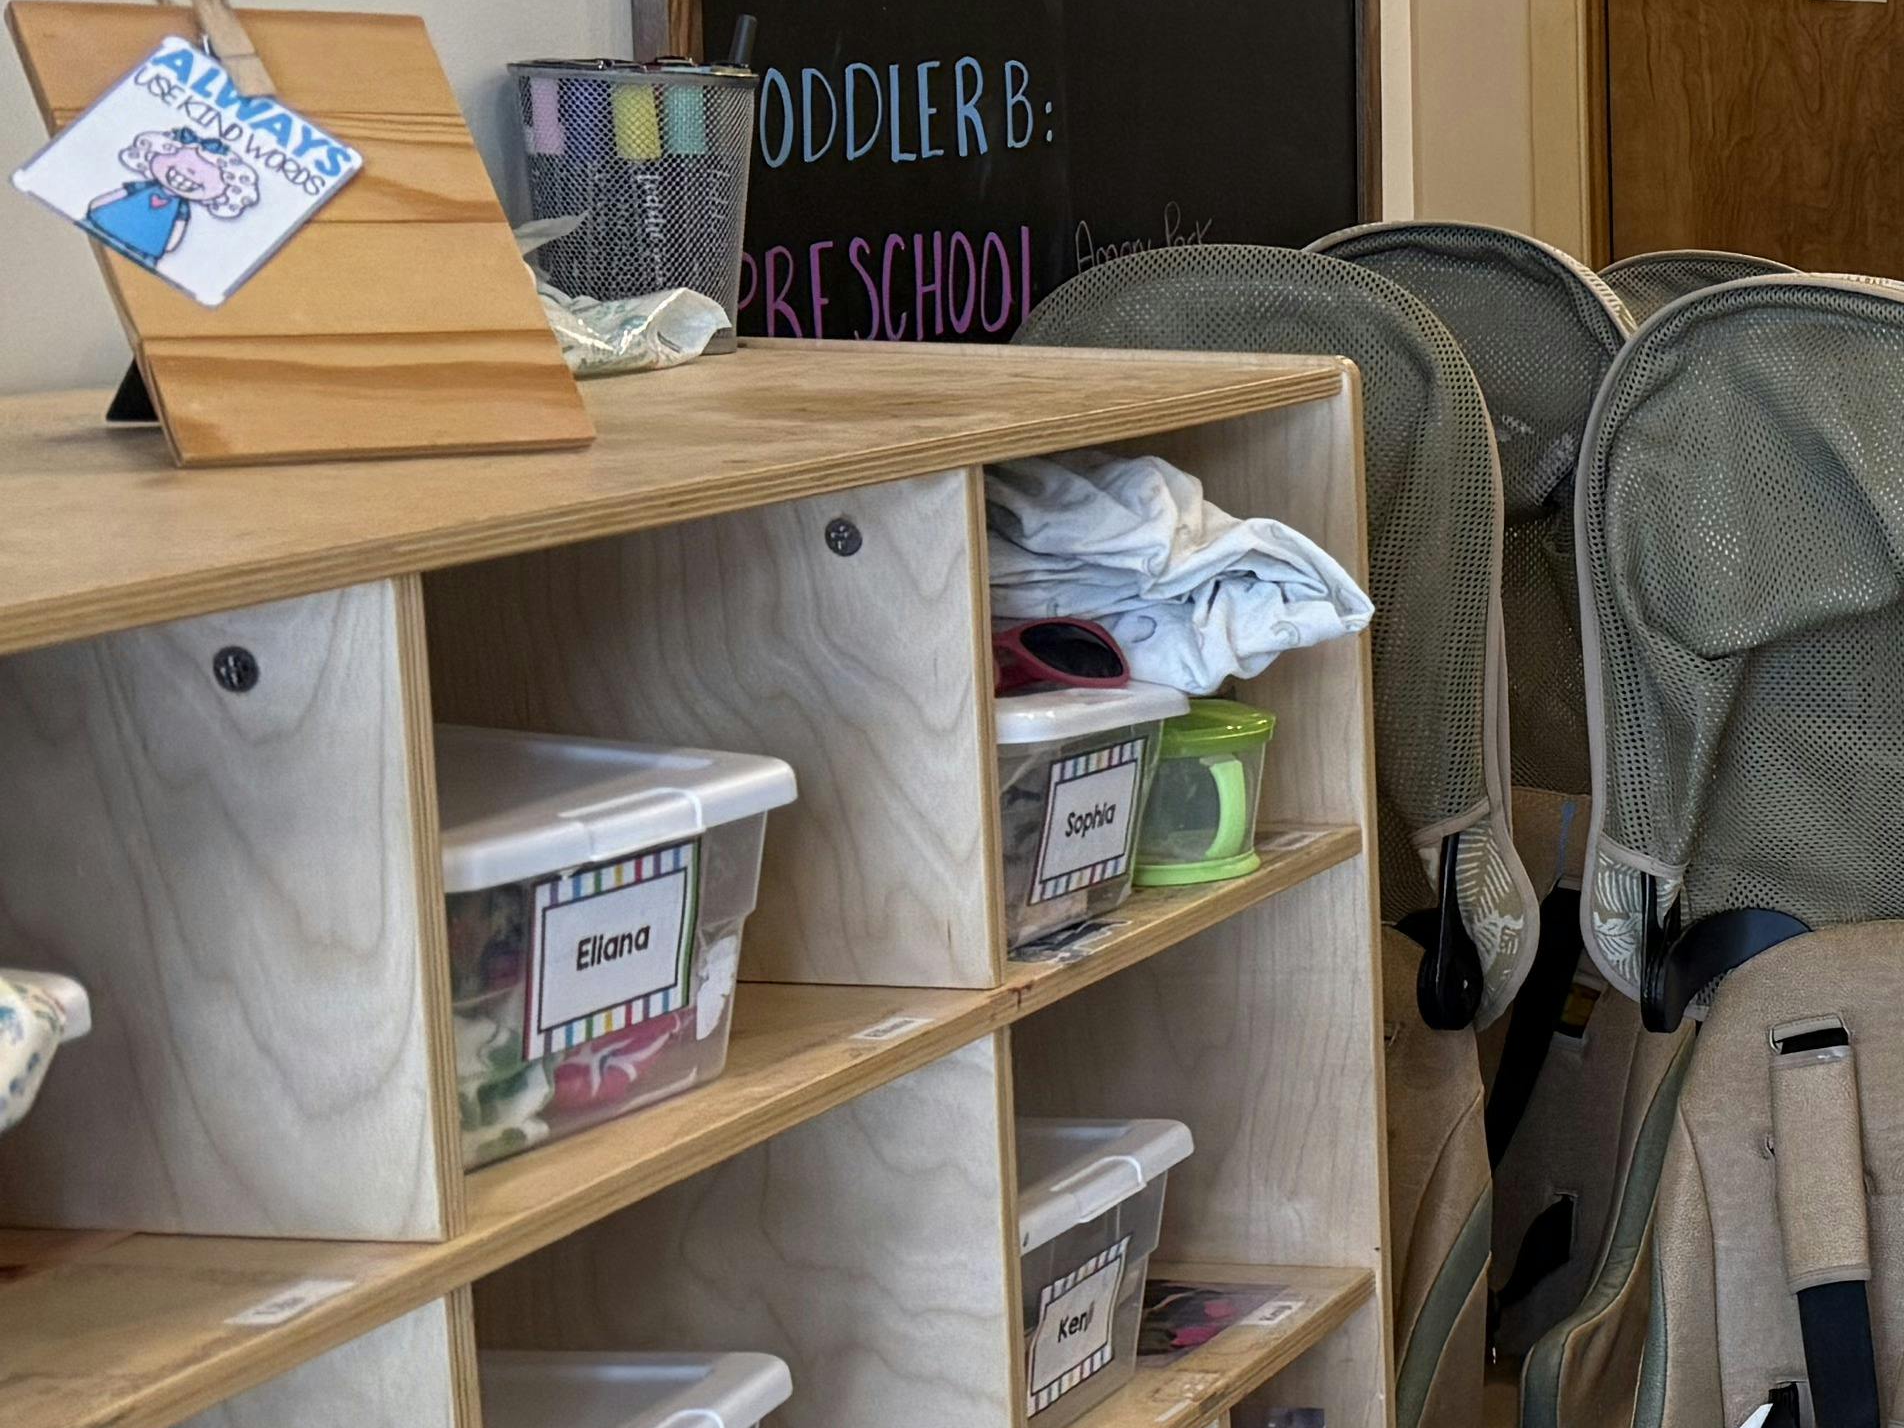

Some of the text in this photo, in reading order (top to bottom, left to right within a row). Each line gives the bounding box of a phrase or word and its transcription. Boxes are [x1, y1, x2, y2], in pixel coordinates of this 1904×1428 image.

[134, 67, 326, 196] USE KIND WORDS
[151, 49, 350, 177] ALWAYS
[760, 56, 1054, 168] ODDLER B:
[1065, 802, 1117, 839] Sophia
[576, 925, 651, 971] Eliana
